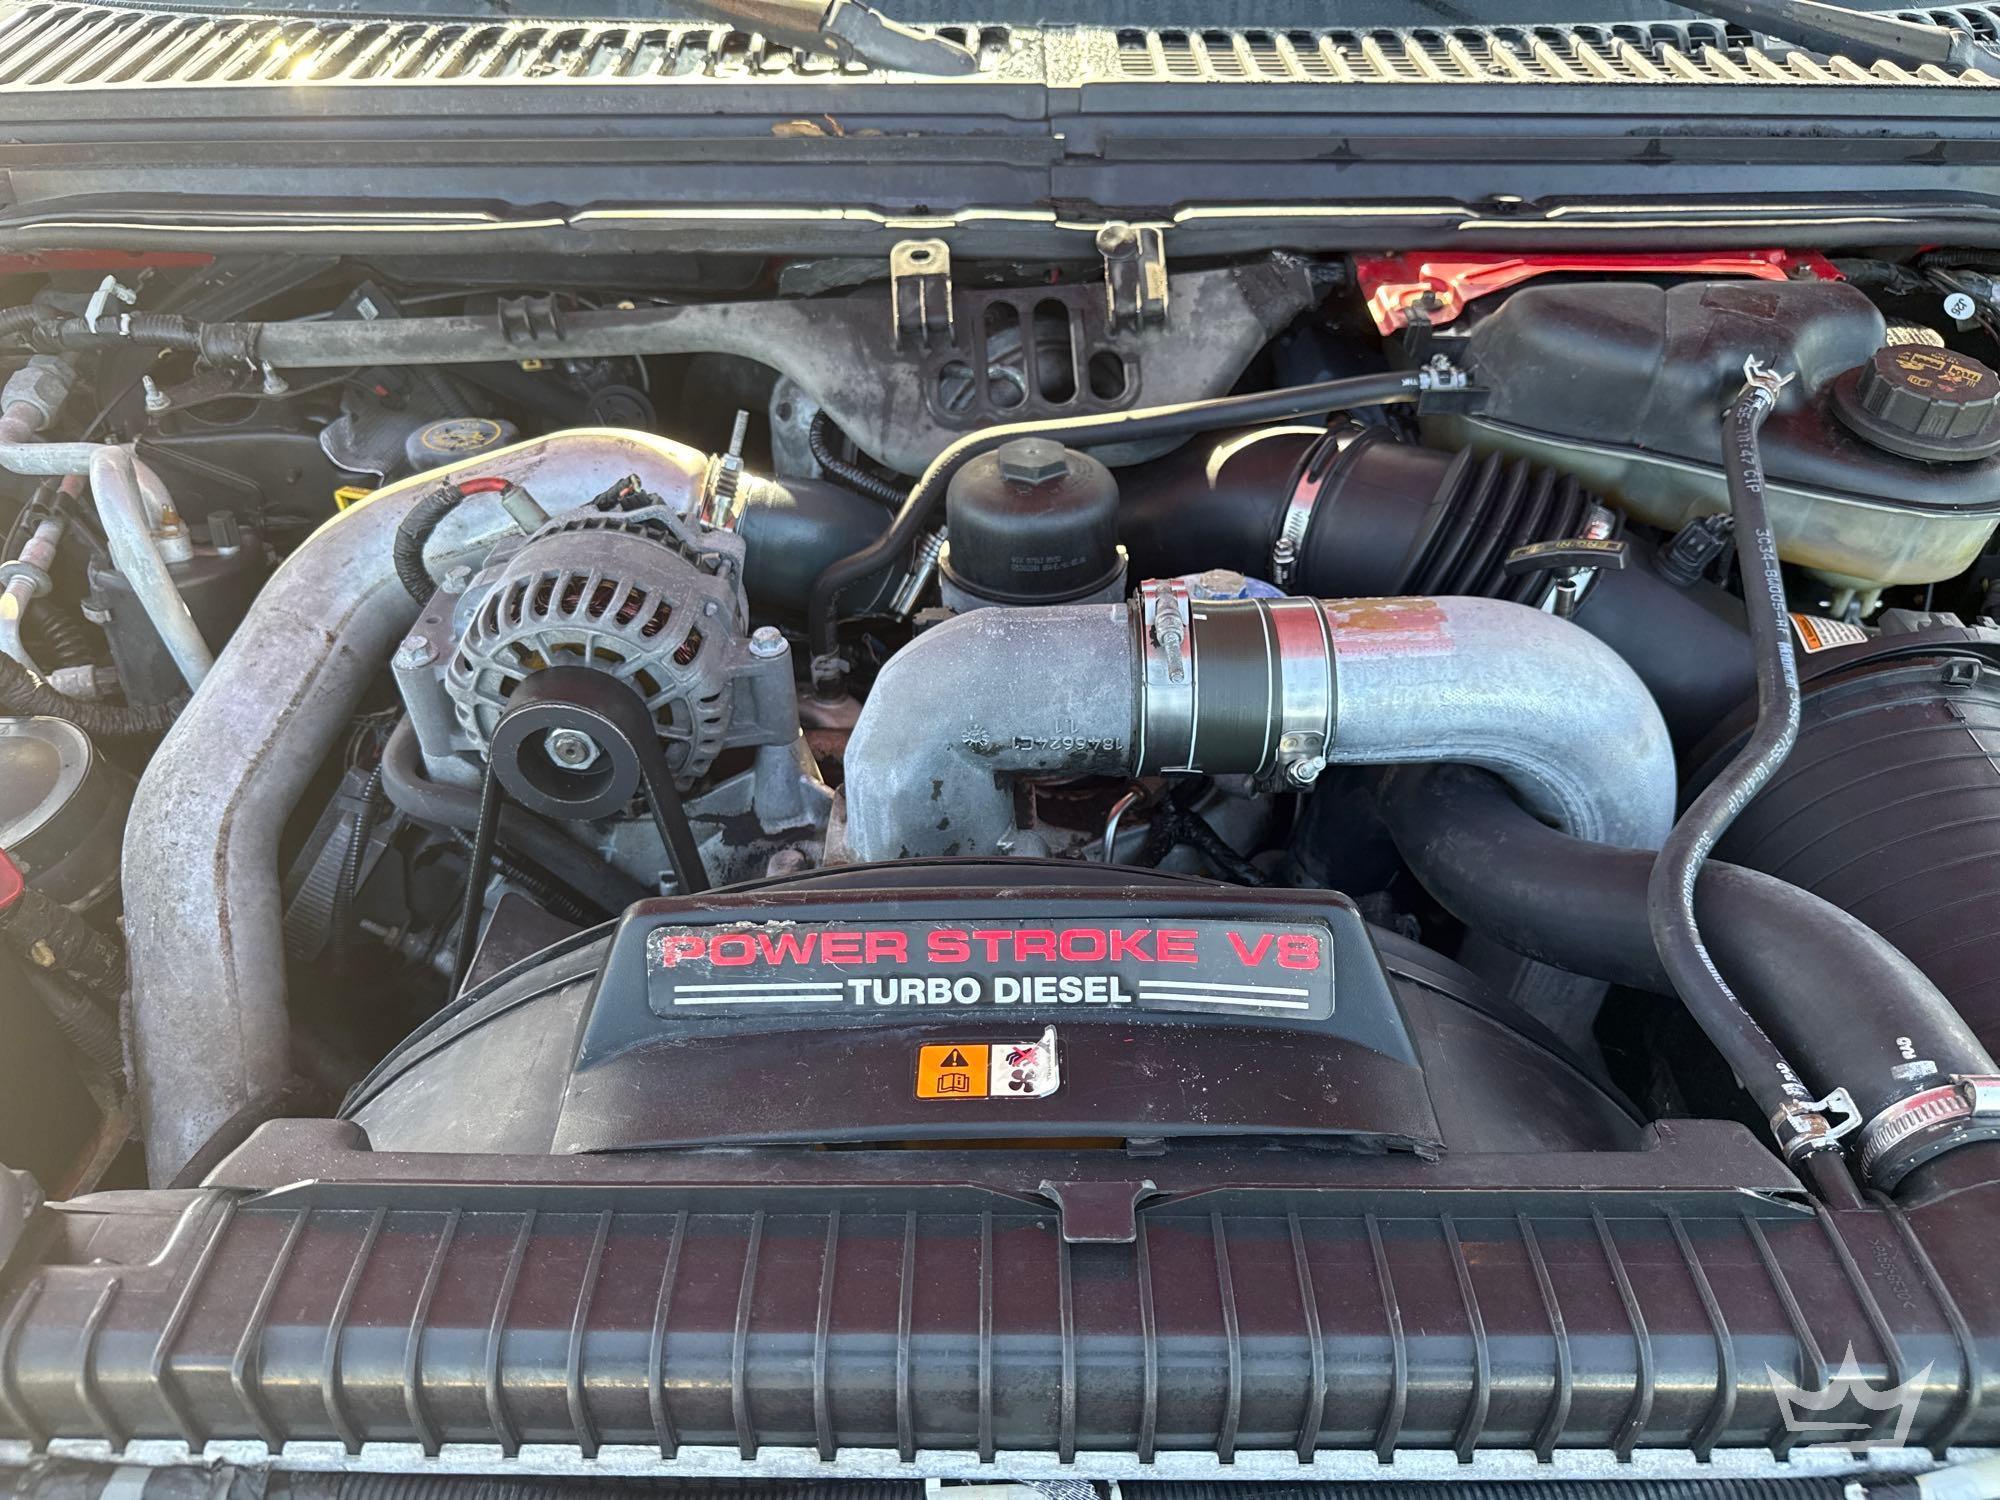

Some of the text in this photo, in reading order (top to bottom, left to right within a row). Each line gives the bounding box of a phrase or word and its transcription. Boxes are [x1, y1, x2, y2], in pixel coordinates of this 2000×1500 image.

[1951, 298, 1967, 316] J26
[1012, 736, 1123, 750] 1846624C1
[663, 928, 1321, 971] POWER STROKE V8
[847, 976, 1132, 1005] TURBO DIESEL
